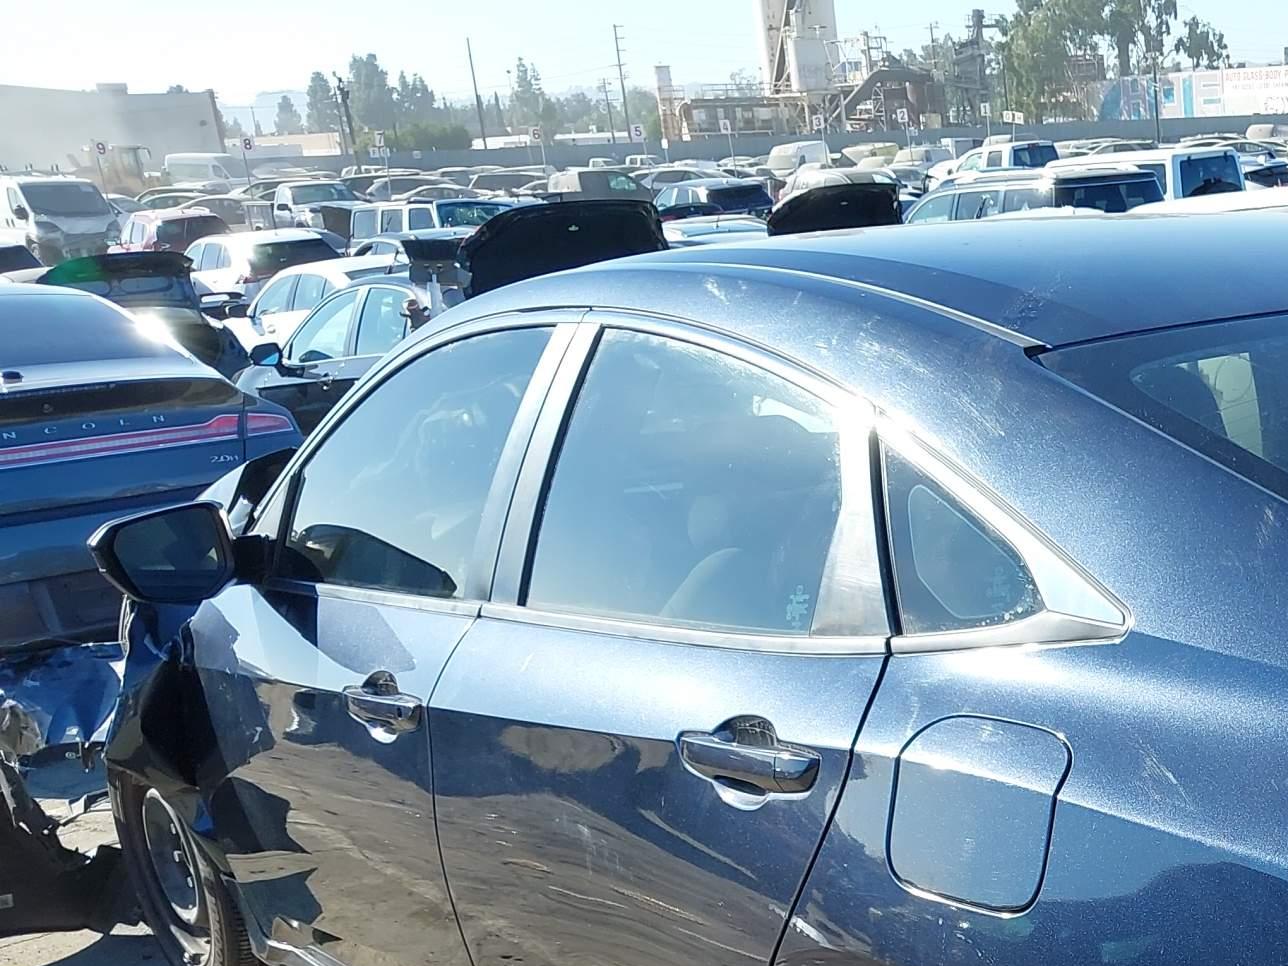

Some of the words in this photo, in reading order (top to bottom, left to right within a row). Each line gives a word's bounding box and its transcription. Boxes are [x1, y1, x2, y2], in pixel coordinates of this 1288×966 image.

[532, 129, 540, 139] 6
[634, 126, 642, 137] 5
[243, 138, 252, 150] 8
[376, 133, 385, 144] 7
[96, 142, 106, 154] 9
